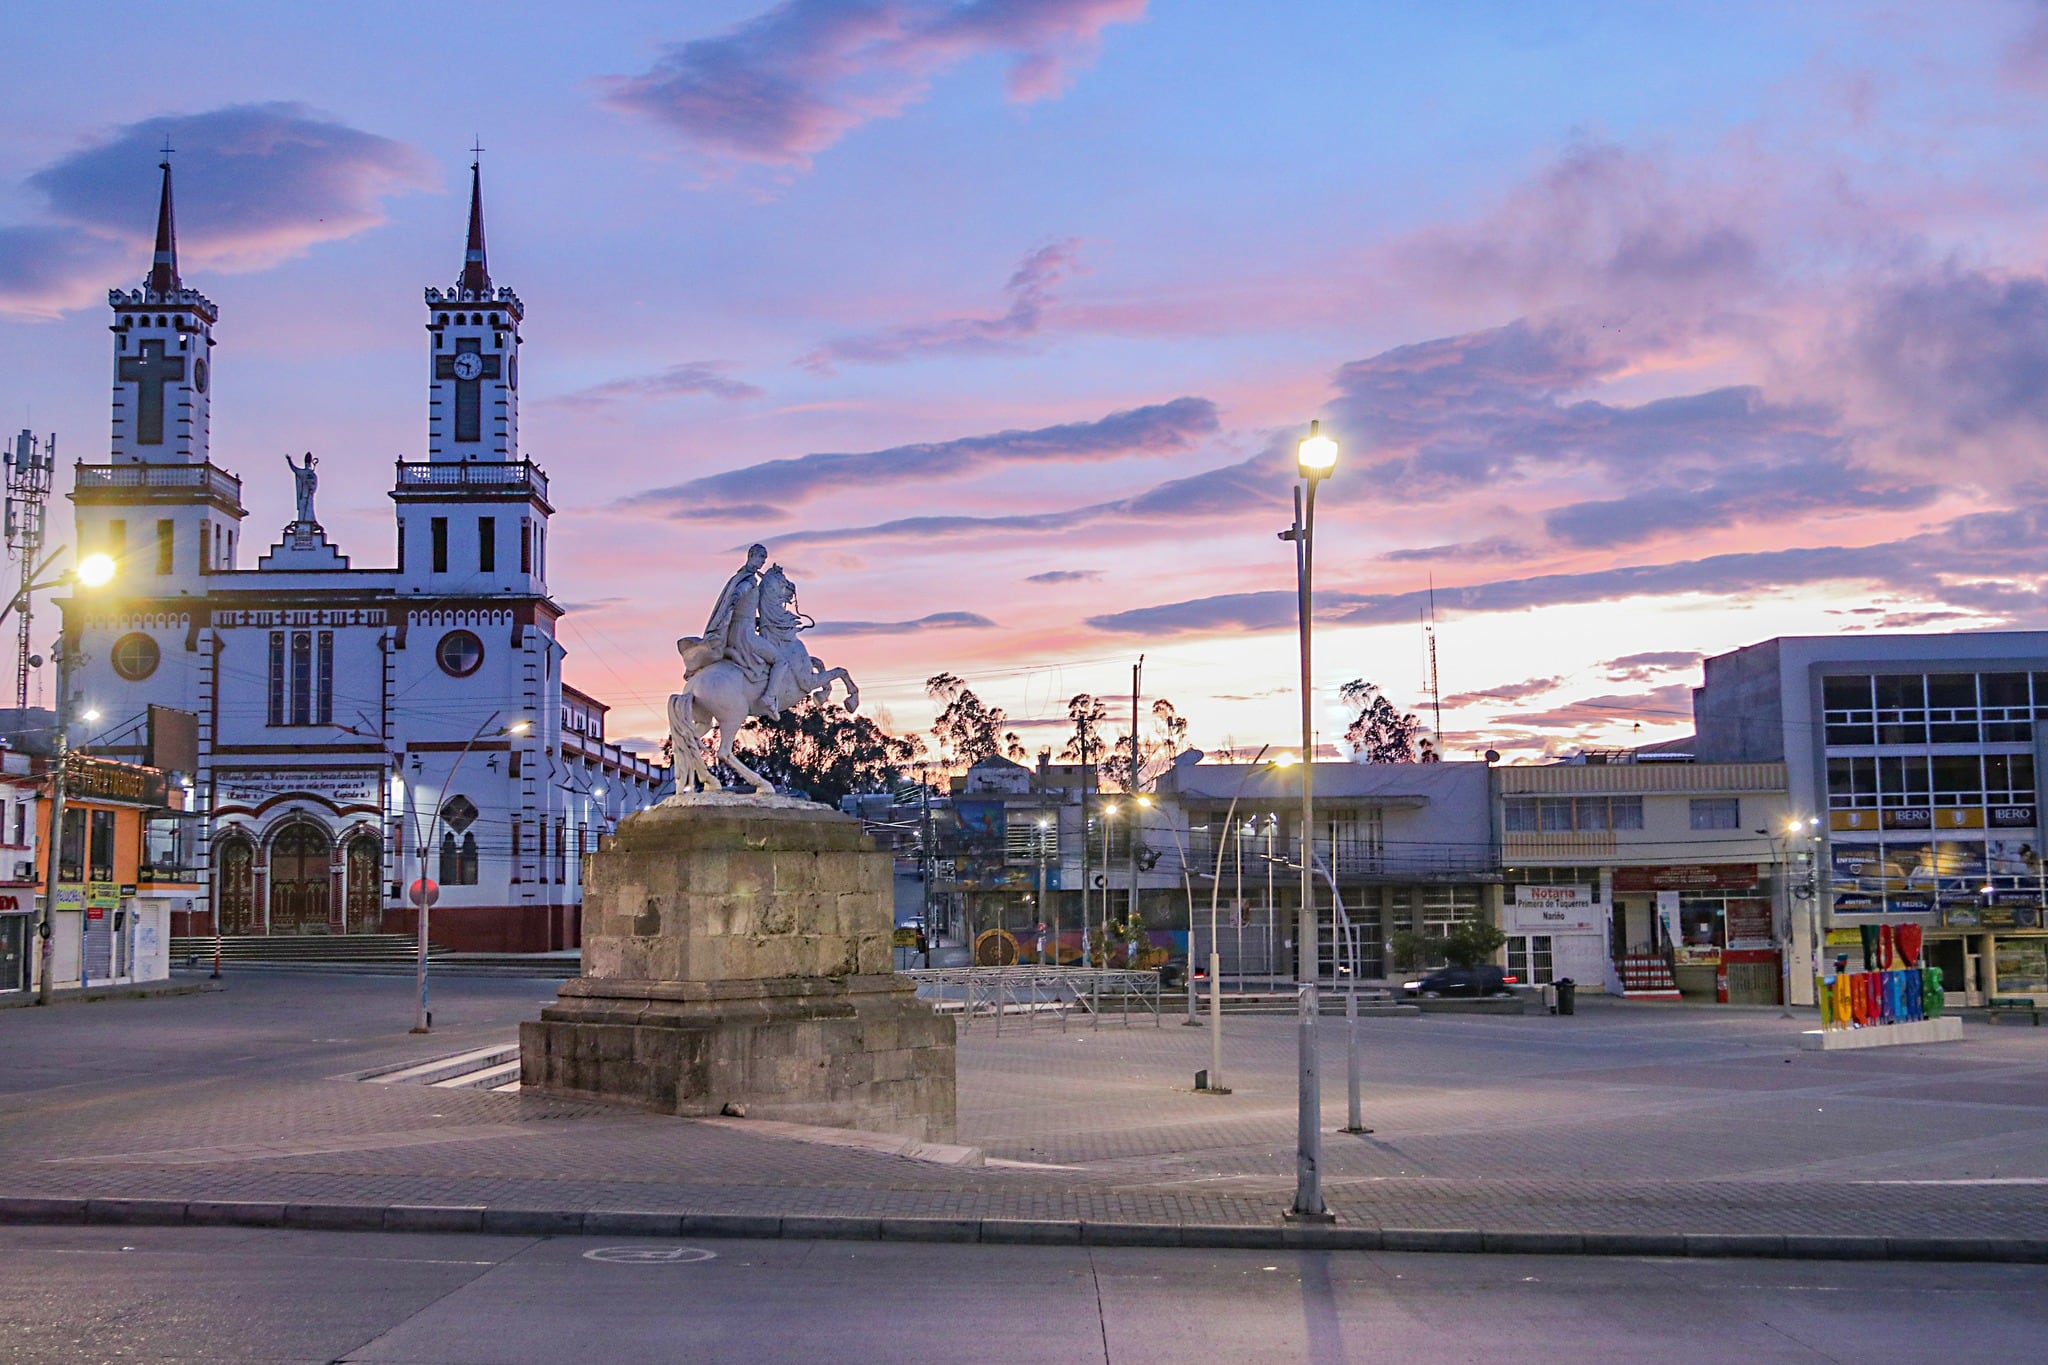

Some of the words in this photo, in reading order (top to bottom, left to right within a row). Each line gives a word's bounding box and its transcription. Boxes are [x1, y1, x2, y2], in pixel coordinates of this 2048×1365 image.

[1895, 810, 1930, 820] IBERO
[1995, 808, 2030, 819] IBERO
[1518, 899, 1544, 908] Primera
[1545, 899, 1554, 908] de
[1543, 911, 1565, 921] Nariño
